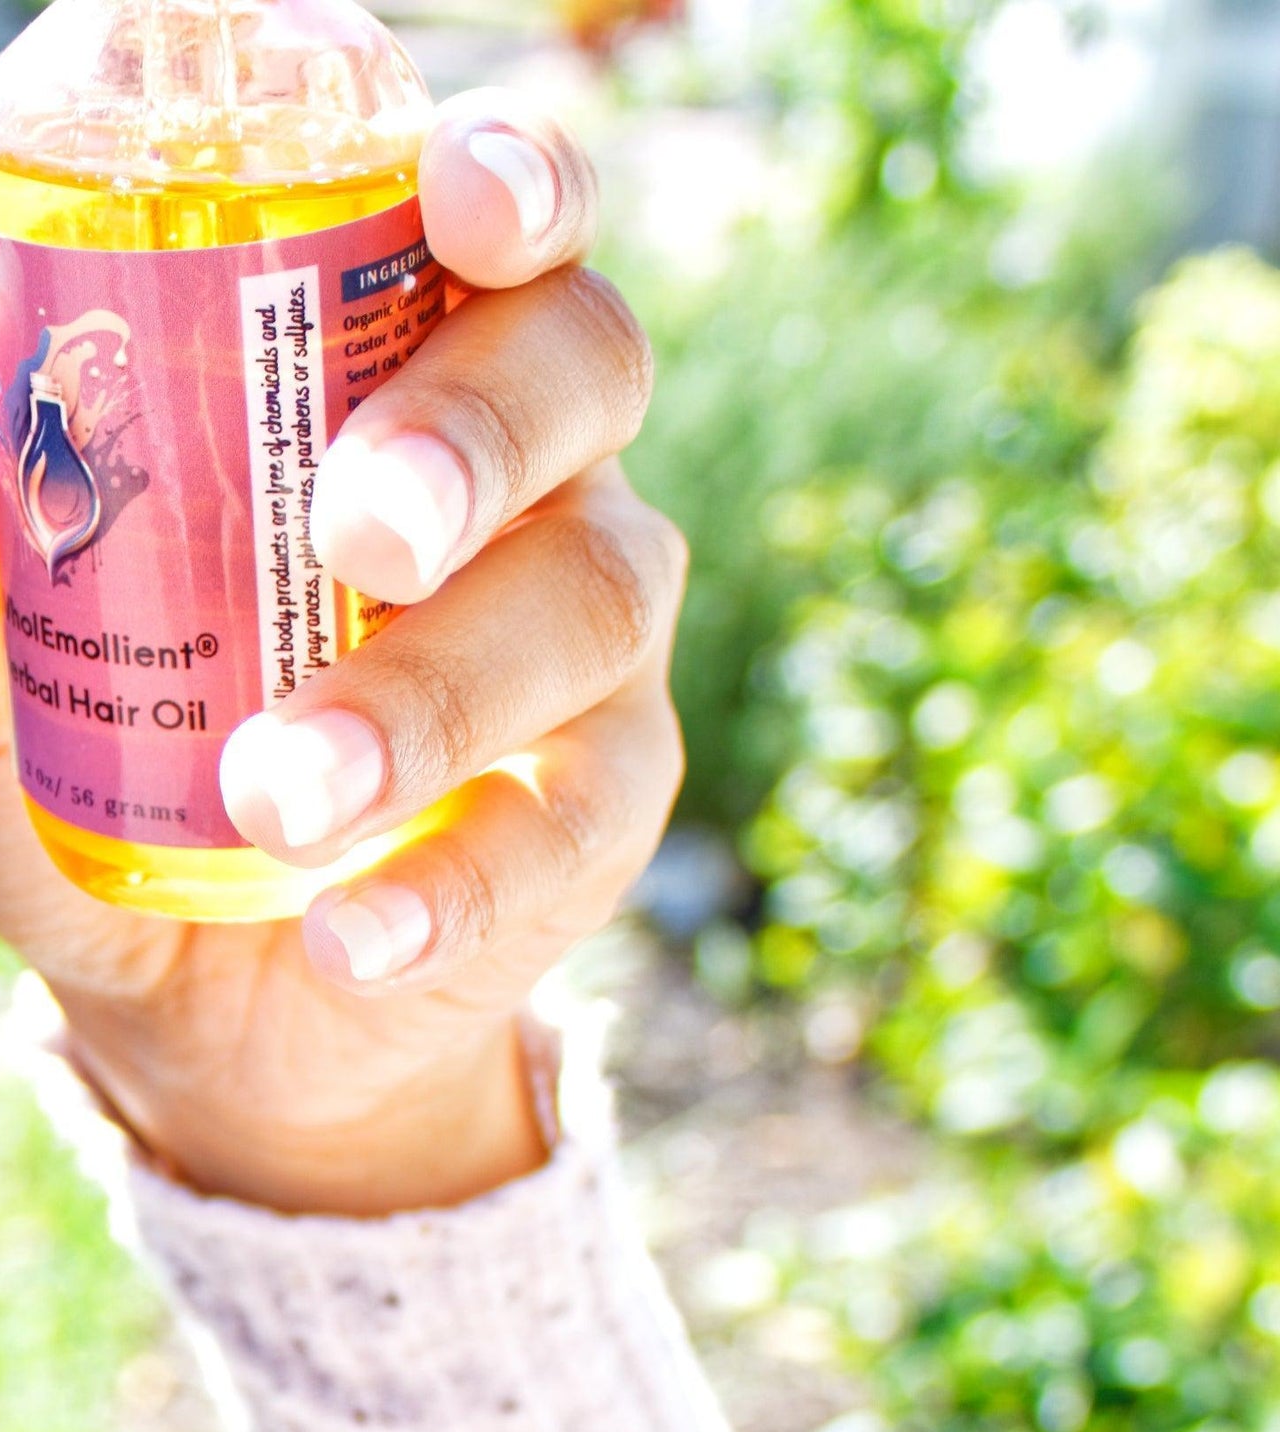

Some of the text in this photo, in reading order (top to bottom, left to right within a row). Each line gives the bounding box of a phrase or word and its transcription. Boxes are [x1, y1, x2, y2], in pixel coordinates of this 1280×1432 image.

[358, 245, 428, 290] INGREDIE
[284, 281, 315, 357] sulfates.
[343, 302, 394, 332] Organic
[344, 332, 388, 358] Castor
[294, 364, 309, 381] or
[346, 360, 377, 385] Seed
[291, 385, 319, 468] parabens
[255, 303, 299, 698] llient body products are free of chemicals and
[6, 597, 218, 669] holEmollient®
[304, 574, 330, 668] fragrances,
[10, 661, 206, 731] erbal Hair Oil
[70, 786, 94, 807] 56
[104, 798, 187, 822] grams
